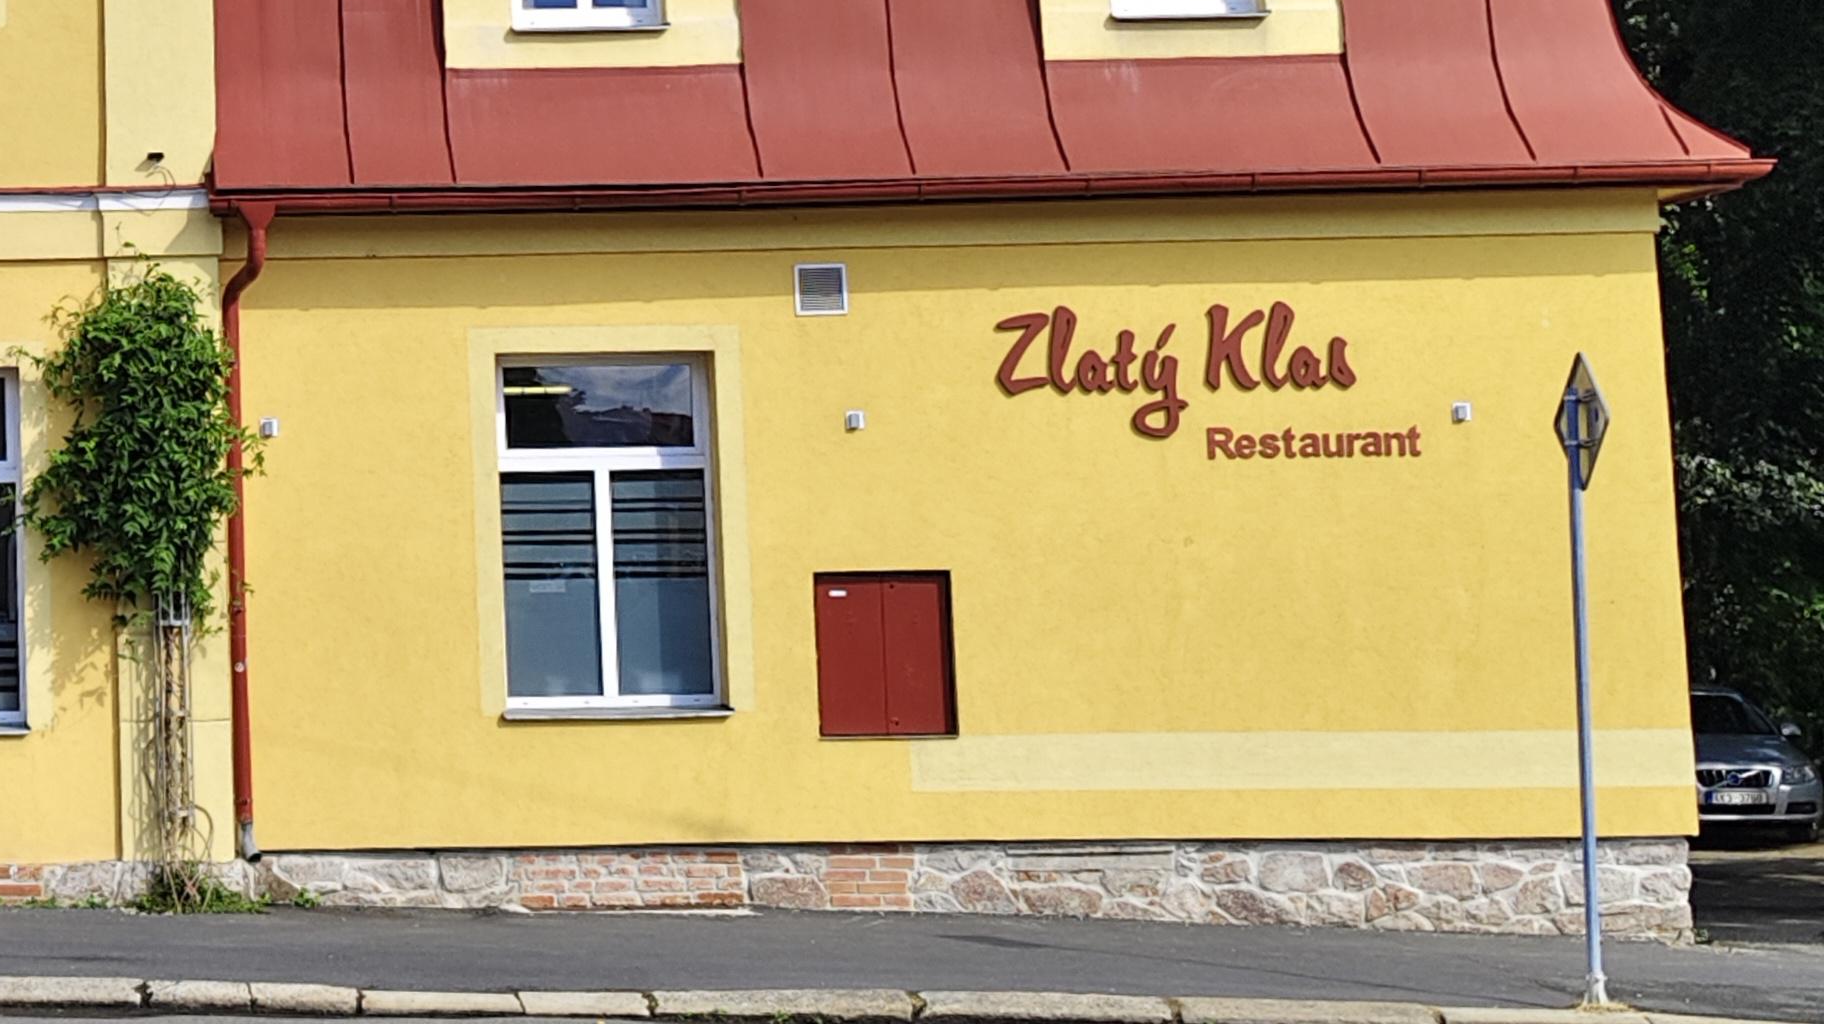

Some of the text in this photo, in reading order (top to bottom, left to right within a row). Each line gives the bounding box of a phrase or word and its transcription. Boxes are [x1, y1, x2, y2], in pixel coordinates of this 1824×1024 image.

[994, 301, 1357, 439] Zlatý Klas
[1206, 425, 1422, 460] Restaurant
